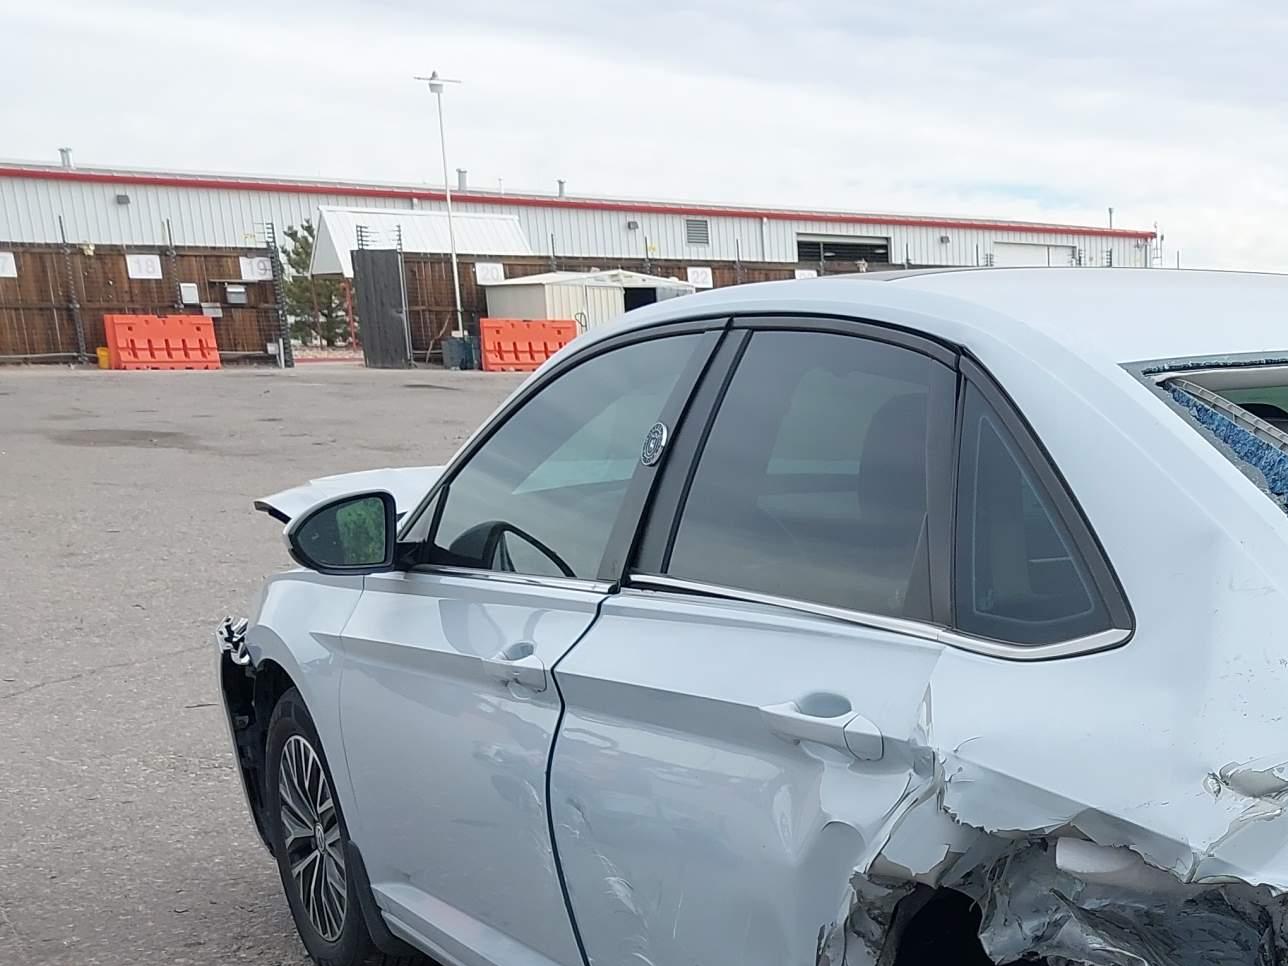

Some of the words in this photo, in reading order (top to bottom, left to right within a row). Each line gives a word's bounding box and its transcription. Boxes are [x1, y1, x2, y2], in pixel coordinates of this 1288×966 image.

[134, 256, 155, 274] 18
[247, 258, 267, 276] 19
[480, 265, 499, 281] 20
